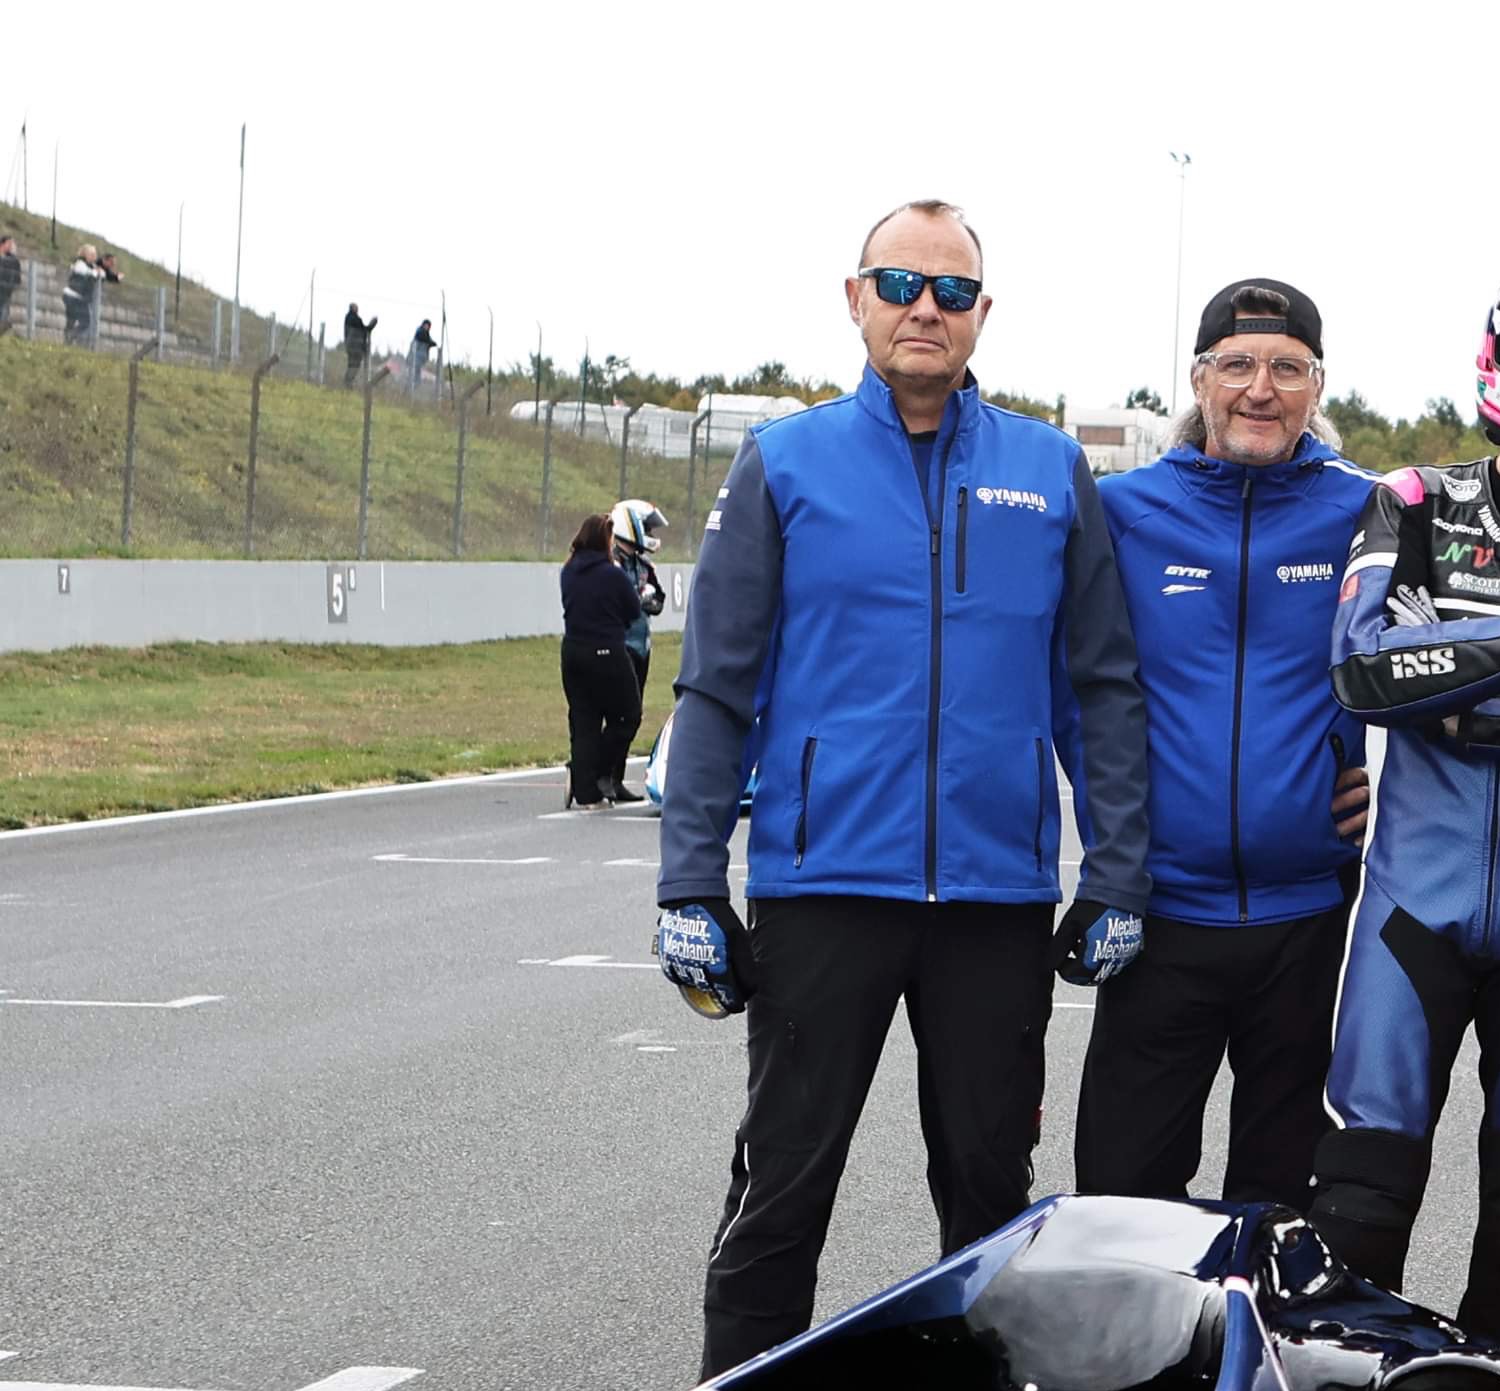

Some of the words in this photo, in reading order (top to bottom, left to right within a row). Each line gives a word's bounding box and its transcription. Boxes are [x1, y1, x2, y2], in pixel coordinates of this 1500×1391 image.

[992, 488, 1047, 509] YAMAHA
[60, 567, 68, 592] 7
[1290, 563, 1334, 578] YAMAHA
[332, 572, 344, 617] 5
[674, 571, 682, 607] 6
[663, 931, 720, 965] Mechanix
